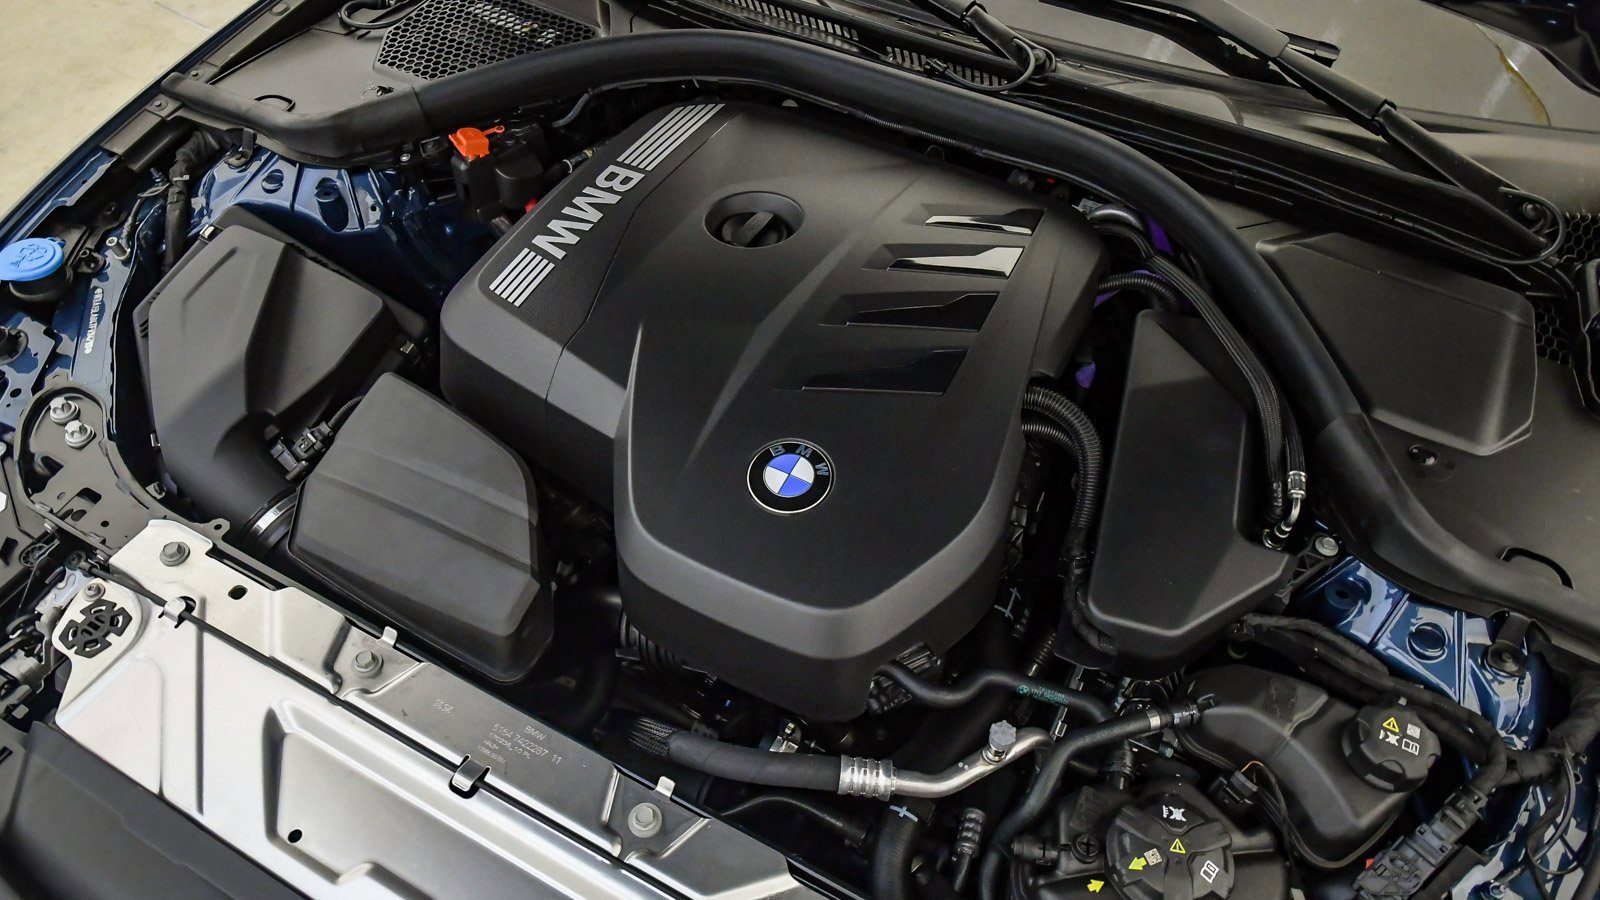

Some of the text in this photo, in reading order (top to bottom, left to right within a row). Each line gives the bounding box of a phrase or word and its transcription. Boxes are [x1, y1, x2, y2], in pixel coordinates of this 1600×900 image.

[532, 164, 645, 260] BMW
[769, 444, 829, 476] BMW
[493, 723, 513, 738] 5164
[514, 733, 549, 757] 7422287
[524, 725, 547, 740] BMW
